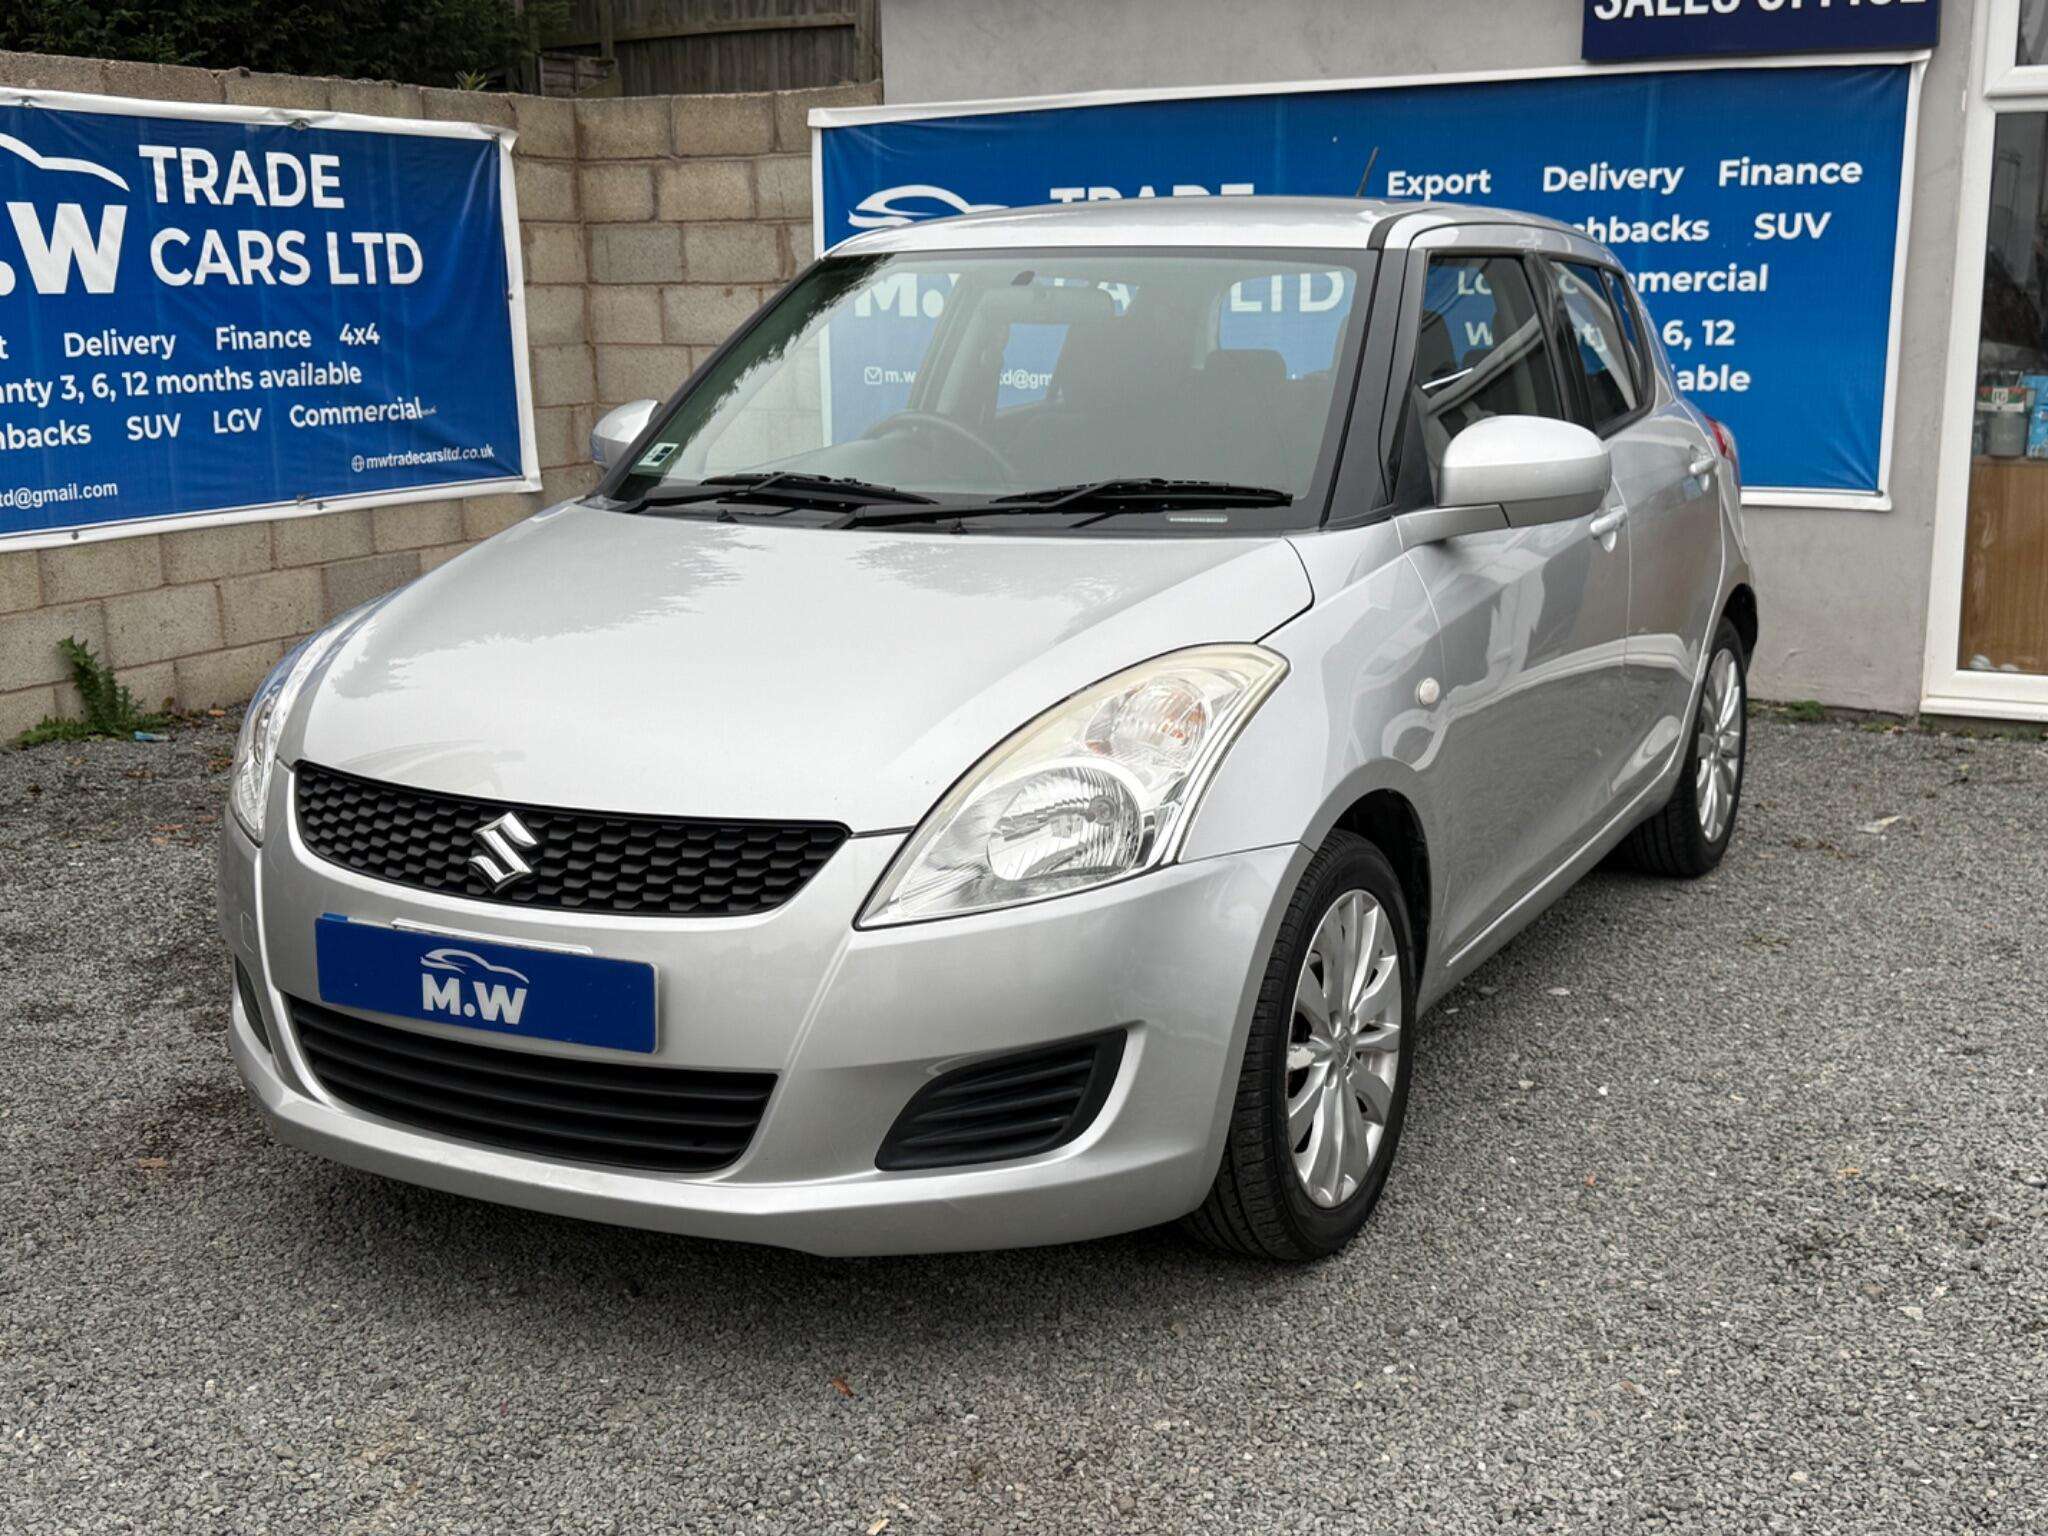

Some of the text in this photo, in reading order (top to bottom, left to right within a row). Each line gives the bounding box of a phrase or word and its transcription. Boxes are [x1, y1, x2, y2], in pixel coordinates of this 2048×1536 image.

[139, 145, 345, 209] TRADE
[1387, 156, 1863, 202] Export Delivery Finance
[1754, 211, 1832, 241] SUV
[151, 228, 424, 286] CARS LTD
[64, 323, 380, 360] Delivery Finance 4x4
[1662, 319, 1736, 351] 6, 12
[60, 375, 85, 404] 3,
[92, 373, 117, 402] 6,
[122, 371, 149, 396] 12
[156, 366, 254, 394] months
[260, 361, 362, 388] available
[1671, 363, 1751, 392] able
[127, 413, 181, 441] SUV
[214, 408, 261, 433] LGV
[290, 397, 422, 427] Commercial
[367, 444, 495, 469] mwtradecarsltd.co.uk
[422, 973, 528, 1025] M.W
